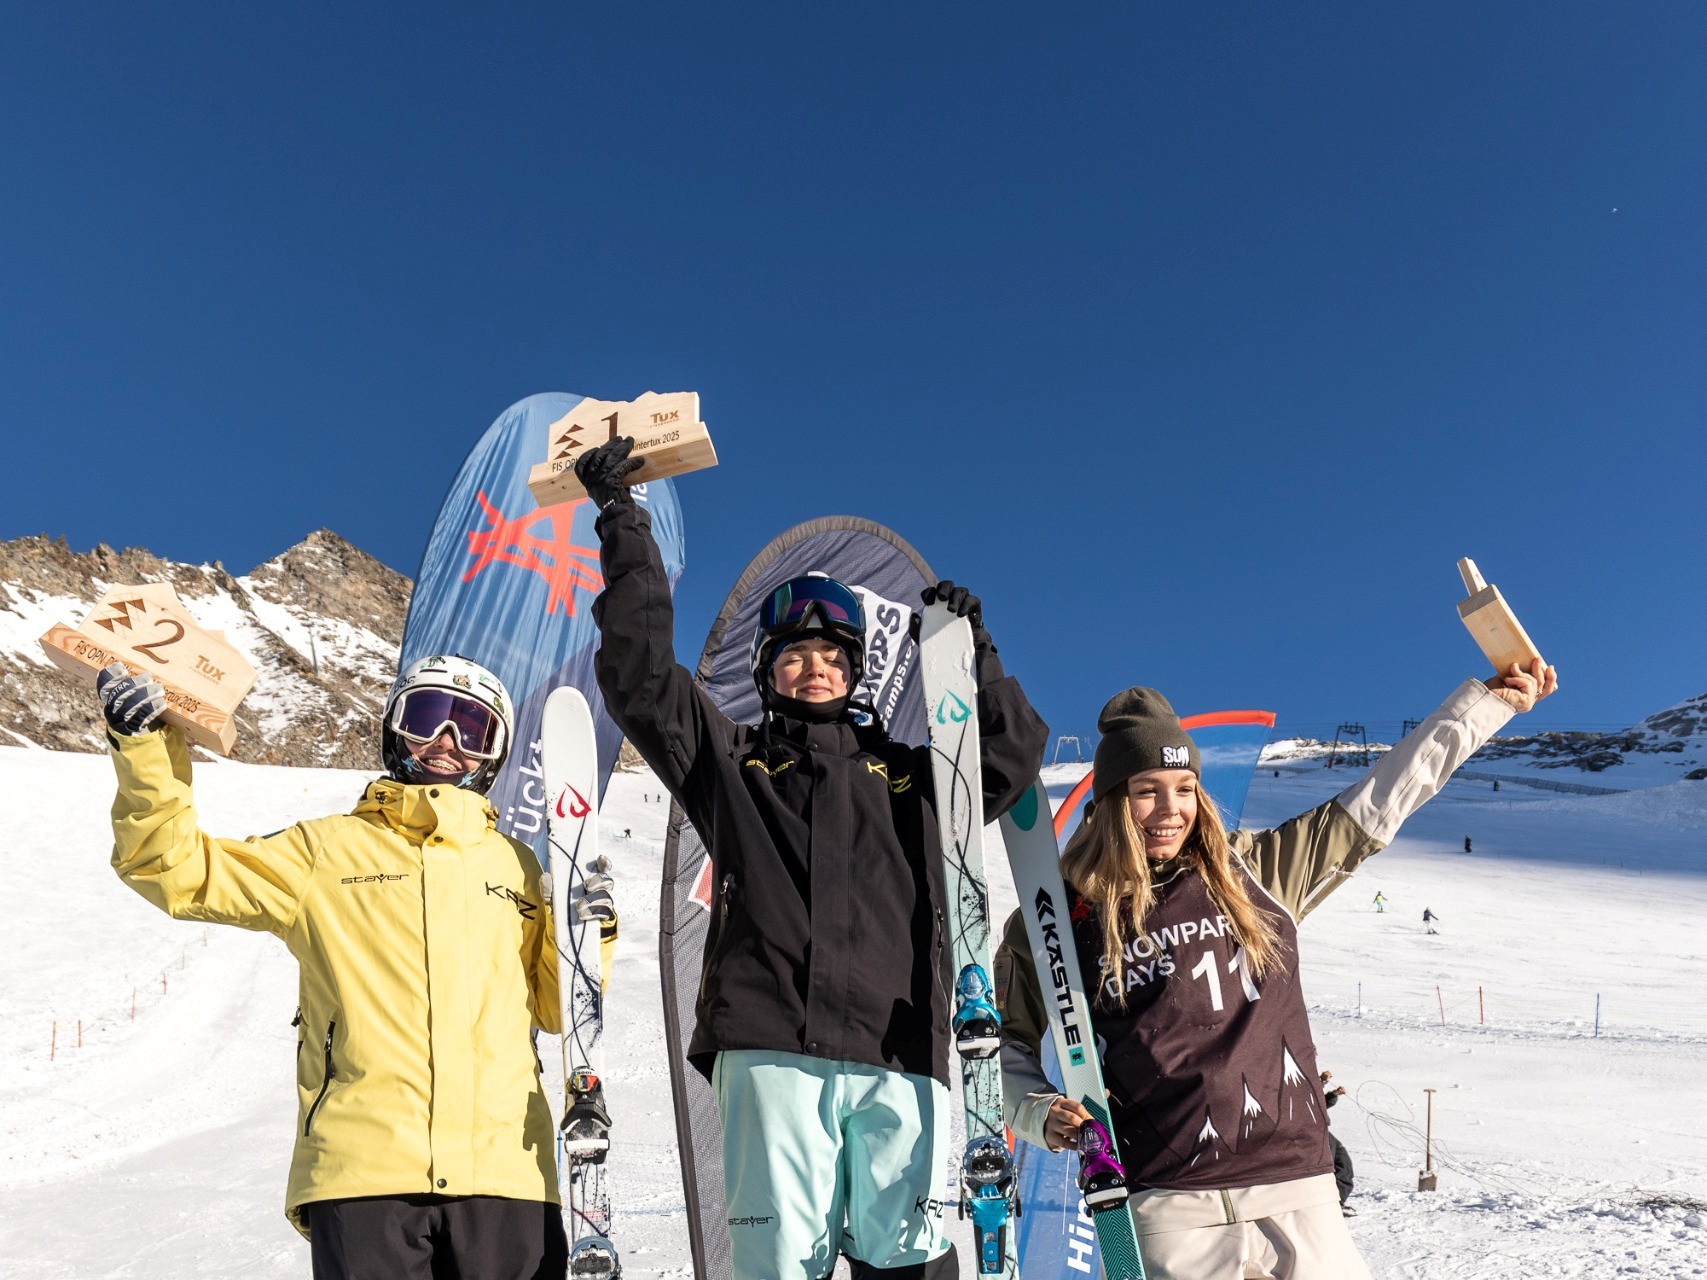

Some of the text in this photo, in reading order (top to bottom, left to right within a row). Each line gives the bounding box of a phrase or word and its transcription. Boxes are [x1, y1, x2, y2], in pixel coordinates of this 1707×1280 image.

[650, 409, 680, 424] Tux
[662, 430, 680, 444] 2025
[552, 461, 563, 473] FIS
[73, 639, 88, 655] FIS
[132, 619, 185, 664] 2
[194, 654, 227, 681] Tux
[177, 693, 201, 713] 2025
[1162, 745, 1190, 766] SUN
[341, 873, 409, 885] stayer
[1098, 914, 1234, 974] SNOWPAR
[1105, 953, 1176, 999] DAYS
[914, 1196, 945, 1219] KAZ
[728, 1215, 774, 1228] stayer
